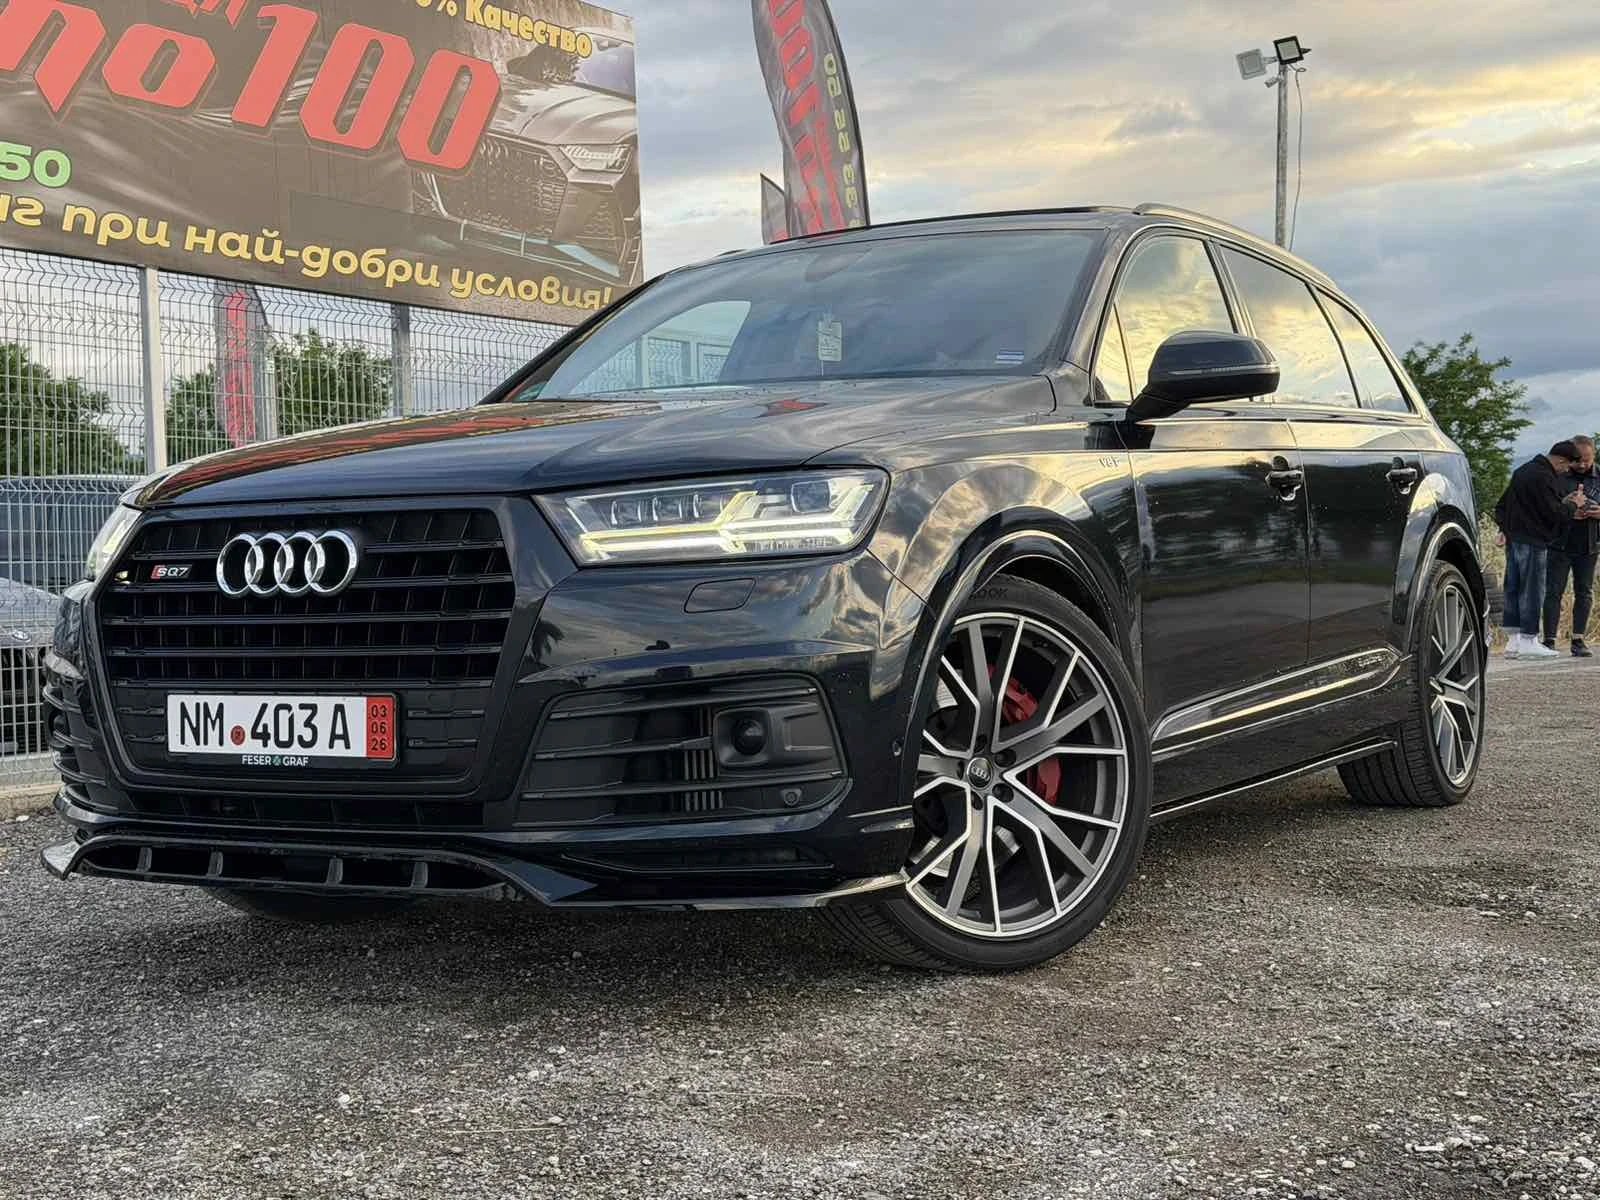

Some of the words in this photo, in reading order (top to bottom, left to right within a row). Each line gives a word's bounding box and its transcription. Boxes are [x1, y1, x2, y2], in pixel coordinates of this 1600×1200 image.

[465, 0, 592, 57] Качество
[62, 204, 170, 246] при
[184, 225, 441, 288] най-добри
[450, 268, 613, 309] условия!
[155, 566, 190, 578] SQ7
[371, 704, 387, 717] 03
[180, 702, 224, 746] NM
[250, 703, 318, 749] 403
[328, 704, 351, 750] A
[371, 721, 387, 734] 06
[371, 737, 387, 751] 26
[242, 755, 272, 766] FESER
[282, 757, 309, 767] GRAF
